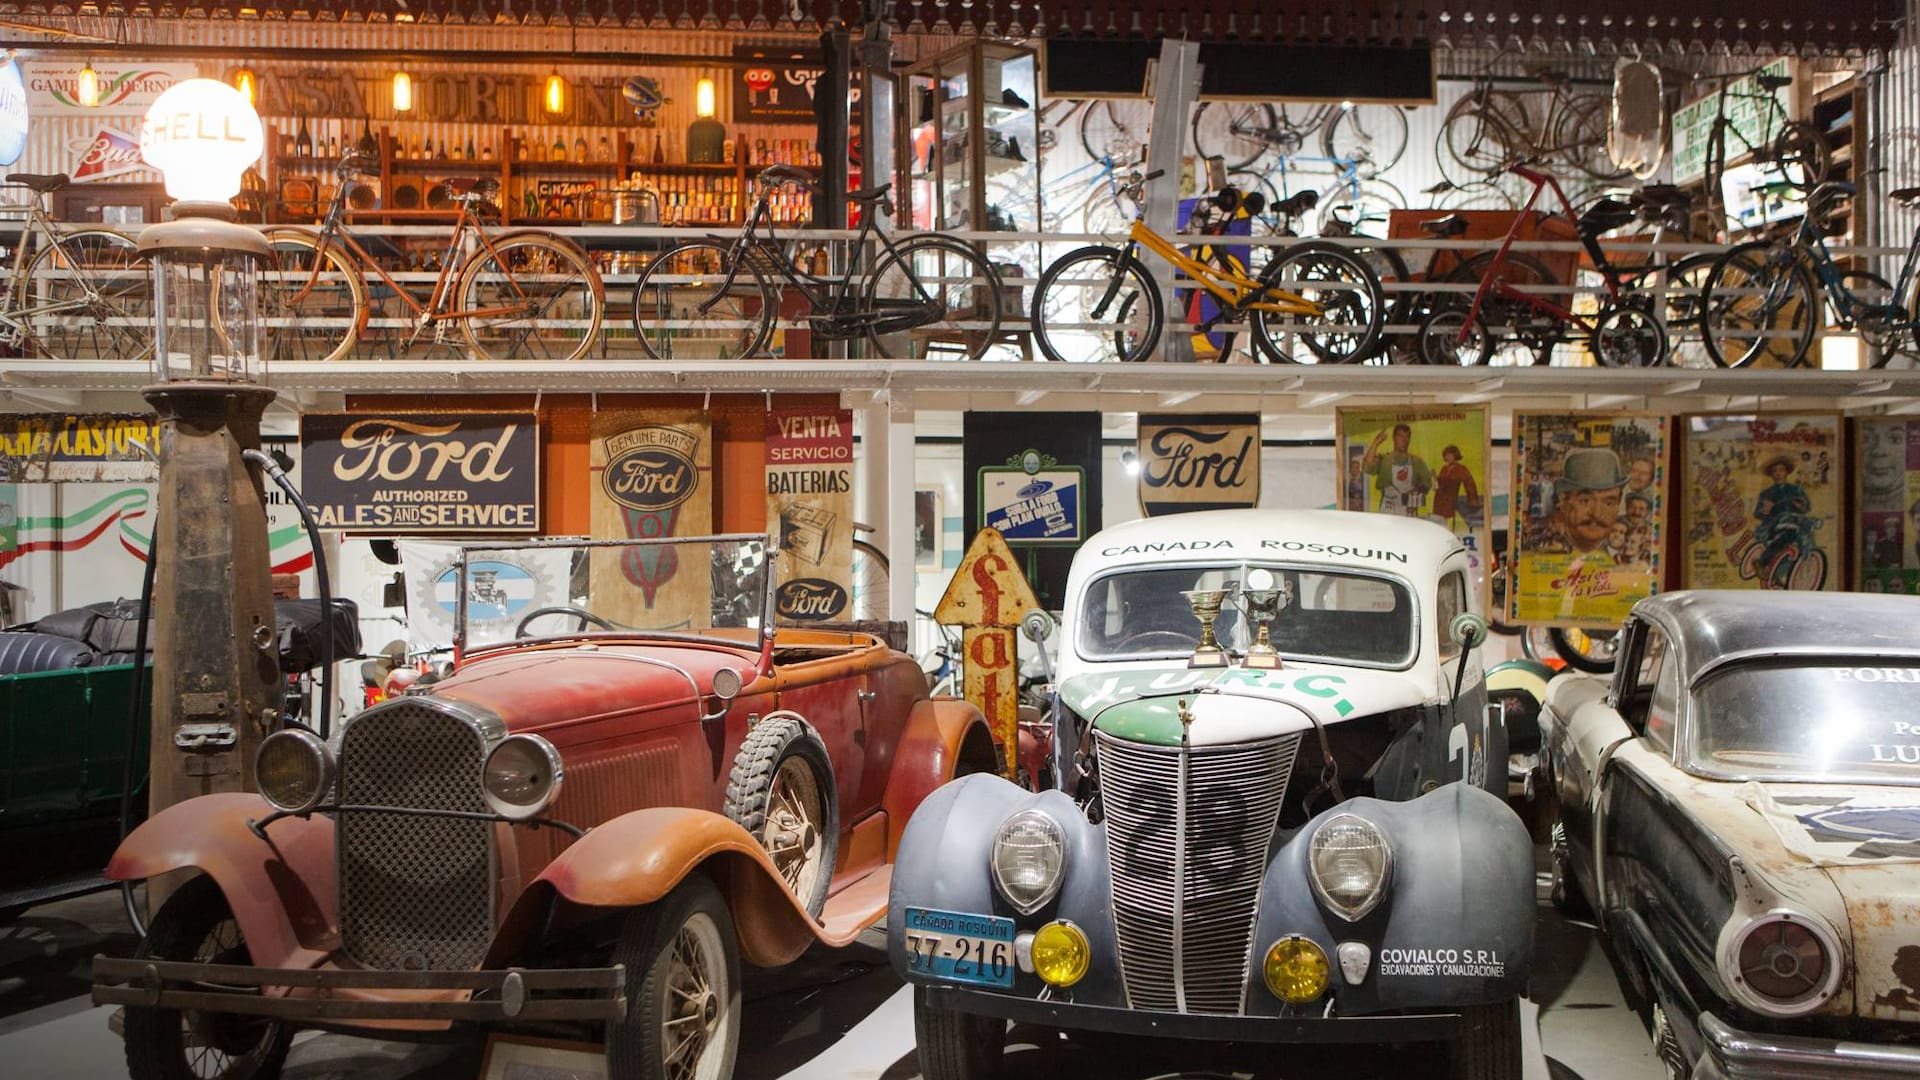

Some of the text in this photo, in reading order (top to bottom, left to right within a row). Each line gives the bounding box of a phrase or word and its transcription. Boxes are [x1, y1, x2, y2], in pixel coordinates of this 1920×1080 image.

[777, 416, 841, 439] VENTA
[333, 419, 518, 482] Ford
[611, 432, 691, 454] GENUINE PARTS
[771, 446, 848, 460] SERVICIO
[1143, 427, 1253, 488] Ford
[615, 460, 685, 494] Ford
[768, 470, 850, 494] BATERIAS
[372, 490, 468, 502] AUTHORIZED
[302, 504, 534, 526] SALES AND SERVICE
[1260, 540, 1408, 563] ROSQUIN
[780, 582, 839, 615] Ford
[907, 935, 1007, 978] 37-216
[1381, 948, 1504, 966] COVIALCO S.R.L.
[1381, 964, 1435, 976] EXCAVACIONES
[1442, 964, 1504, 977] CANALIZACIONES
